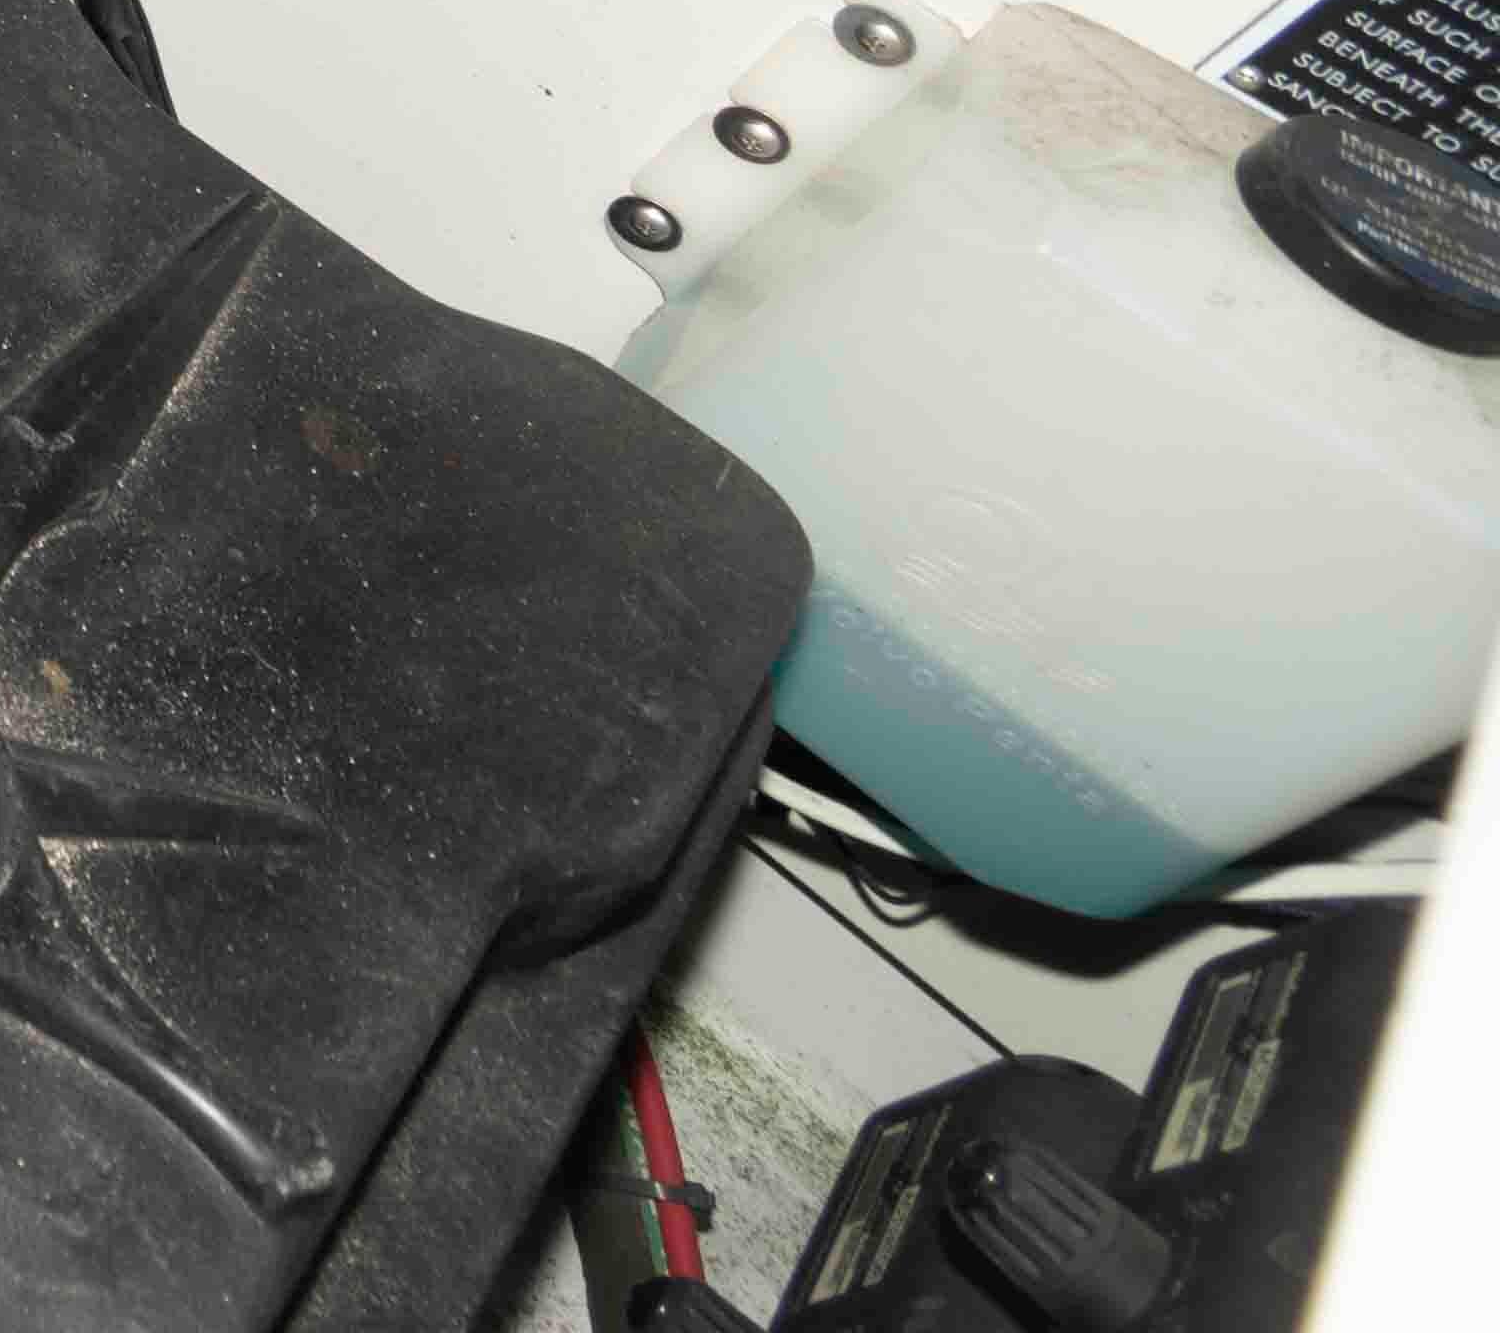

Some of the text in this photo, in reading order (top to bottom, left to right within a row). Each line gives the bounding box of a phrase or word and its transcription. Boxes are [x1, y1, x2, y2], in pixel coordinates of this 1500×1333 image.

[1318, 29, 1449, 111] BENEATH
[1345, 9, 1500, 108] SURFACE O
[1407, 8, 1493, 62] SUCH
[1267, 71, 1359, 122] SANC
[1292, 51, 1500, 186] SUBJECT TO SU
